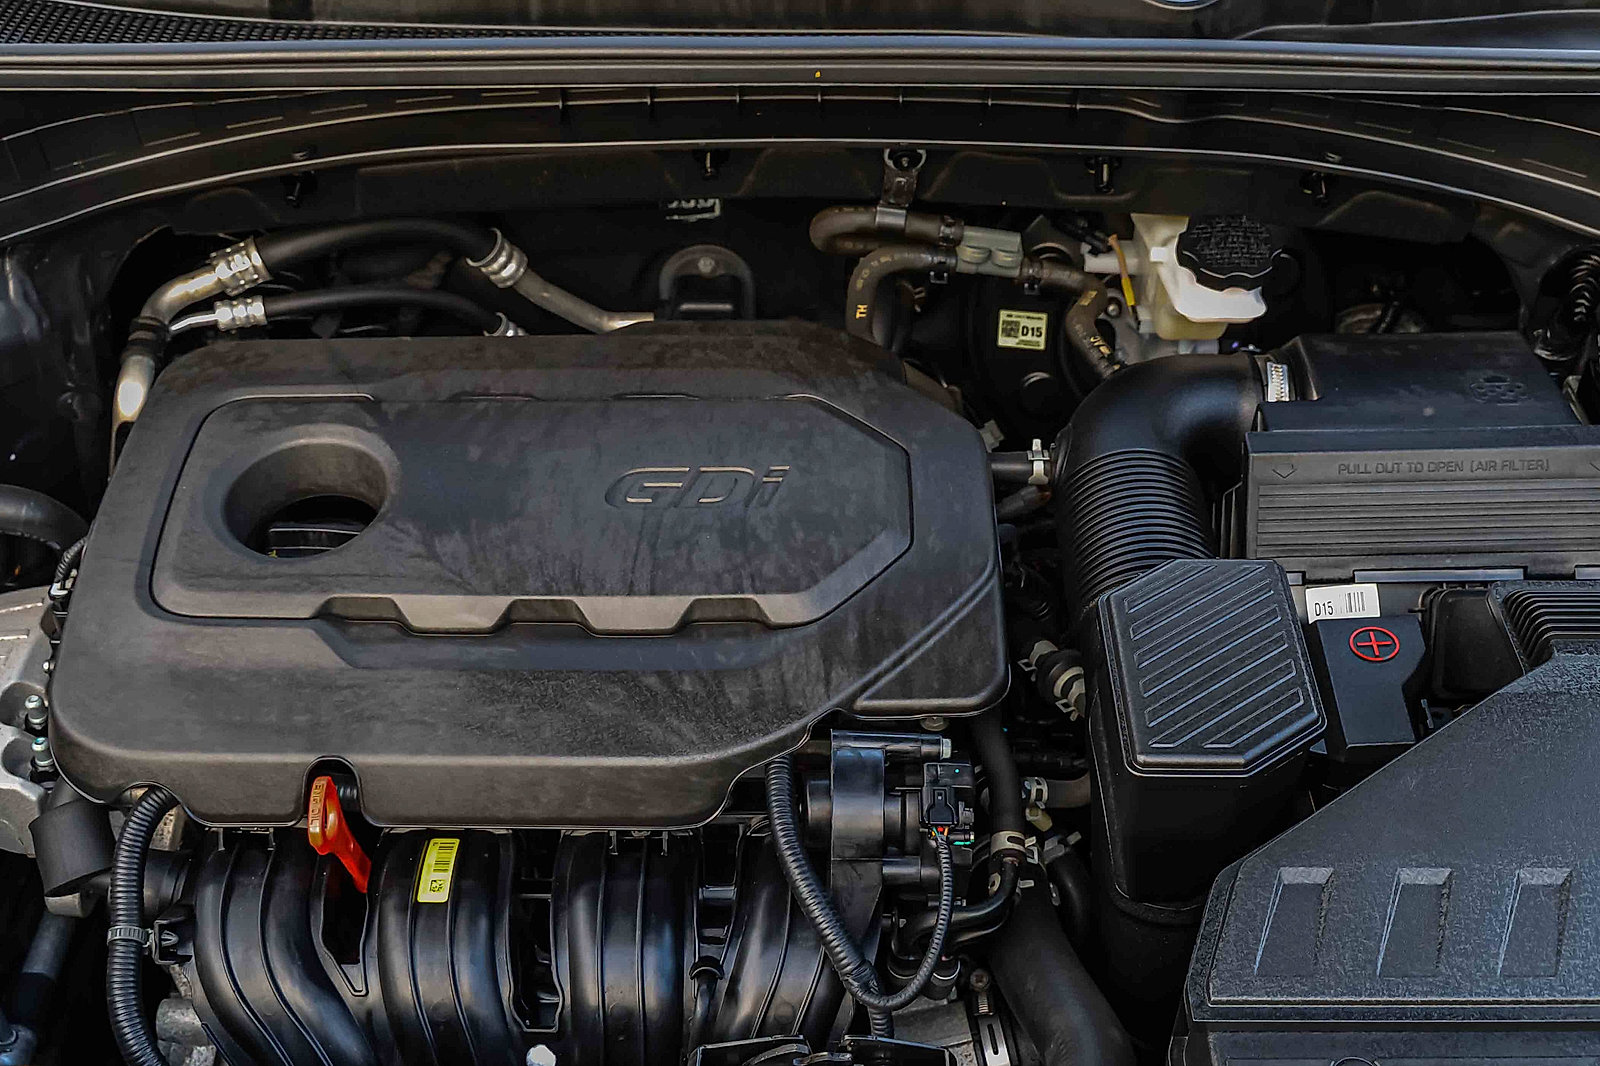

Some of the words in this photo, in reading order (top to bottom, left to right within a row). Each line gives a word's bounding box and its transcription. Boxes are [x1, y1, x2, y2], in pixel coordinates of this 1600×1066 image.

[1021, 325, 1043, 338] D15
[1337, 462, 1372, 475] PULL
[1375, 461, 1403, 474] OUT
[1406, 460, 1424, 473] TO
[1427, 460, 1464, 473] OPEN
[604, 465, 791, 509] GDi
[1314, 600, 1334, 617] D15
[310, 807, 321, 826] OIL
